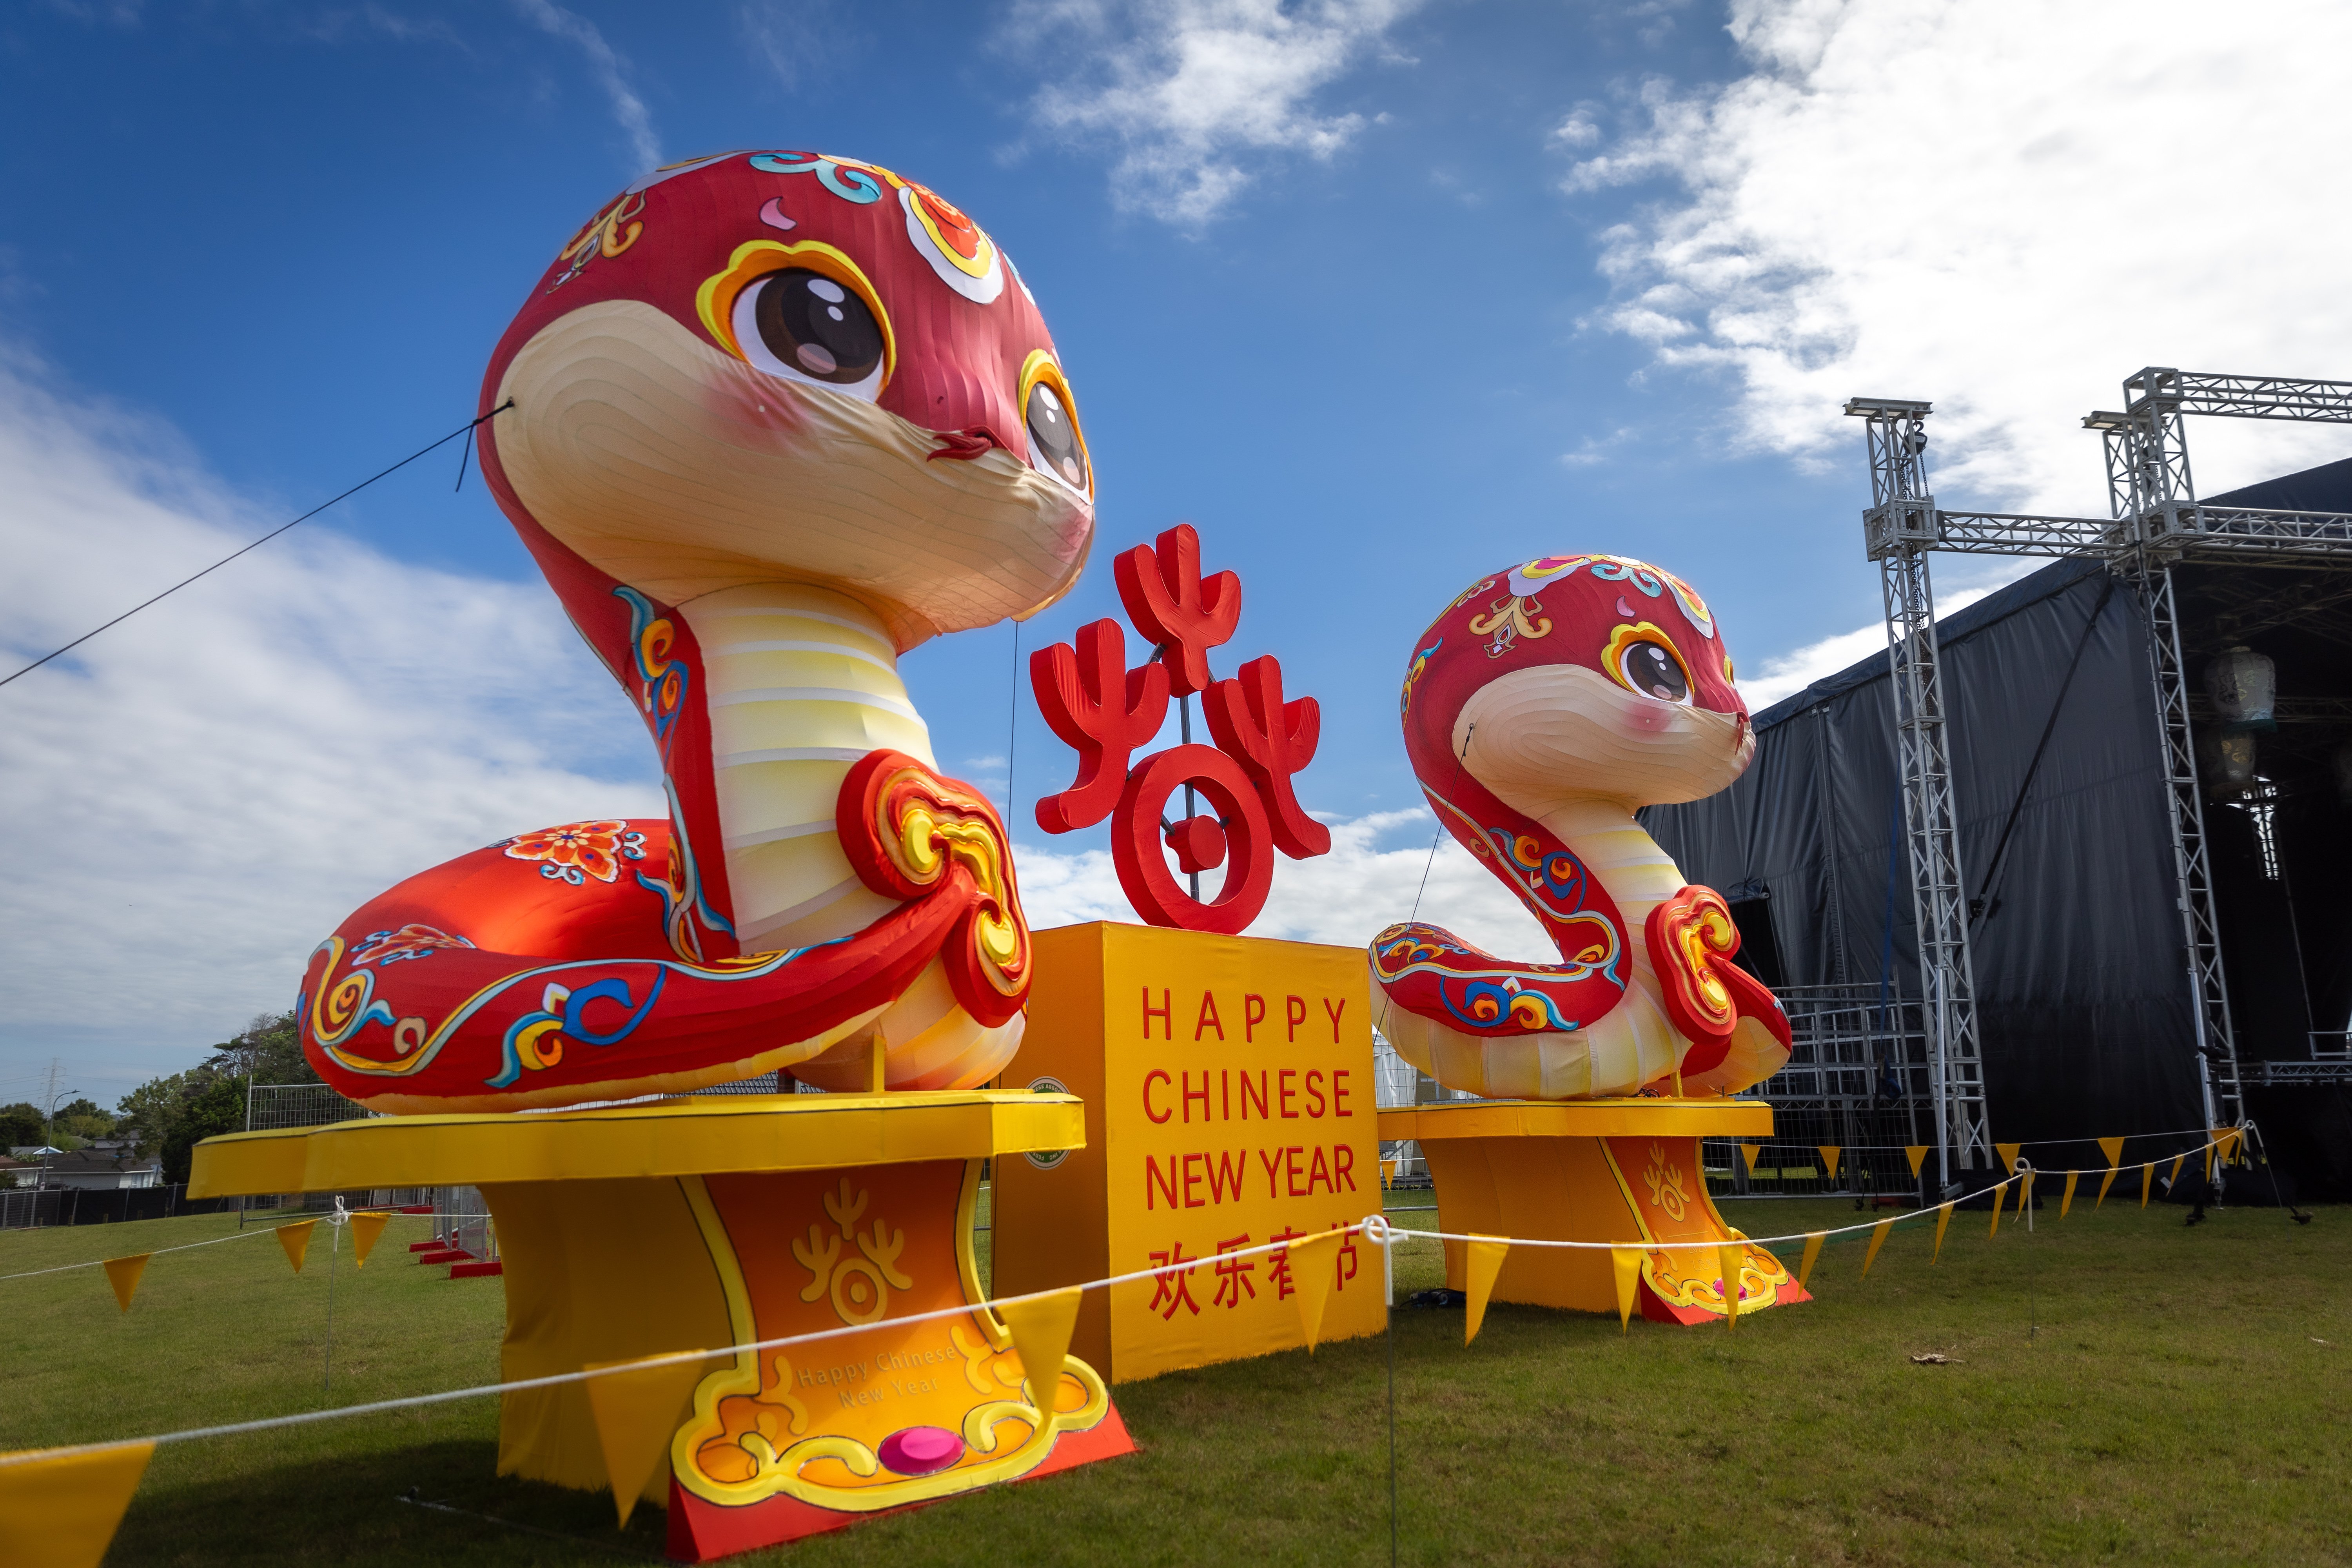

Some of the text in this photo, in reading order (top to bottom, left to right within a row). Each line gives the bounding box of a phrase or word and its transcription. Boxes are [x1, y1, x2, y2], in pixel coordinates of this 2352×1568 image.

[1142, 986, 1346, 1044] HAPPY
[1143, 1069, 1353, 1124] CHINESE
[1146, 1143, 1357, 1210] NEW YEAR
[797, 1345, 956, 1388] Happy Chinese
[838, 1376, 940, 1409] New Year
